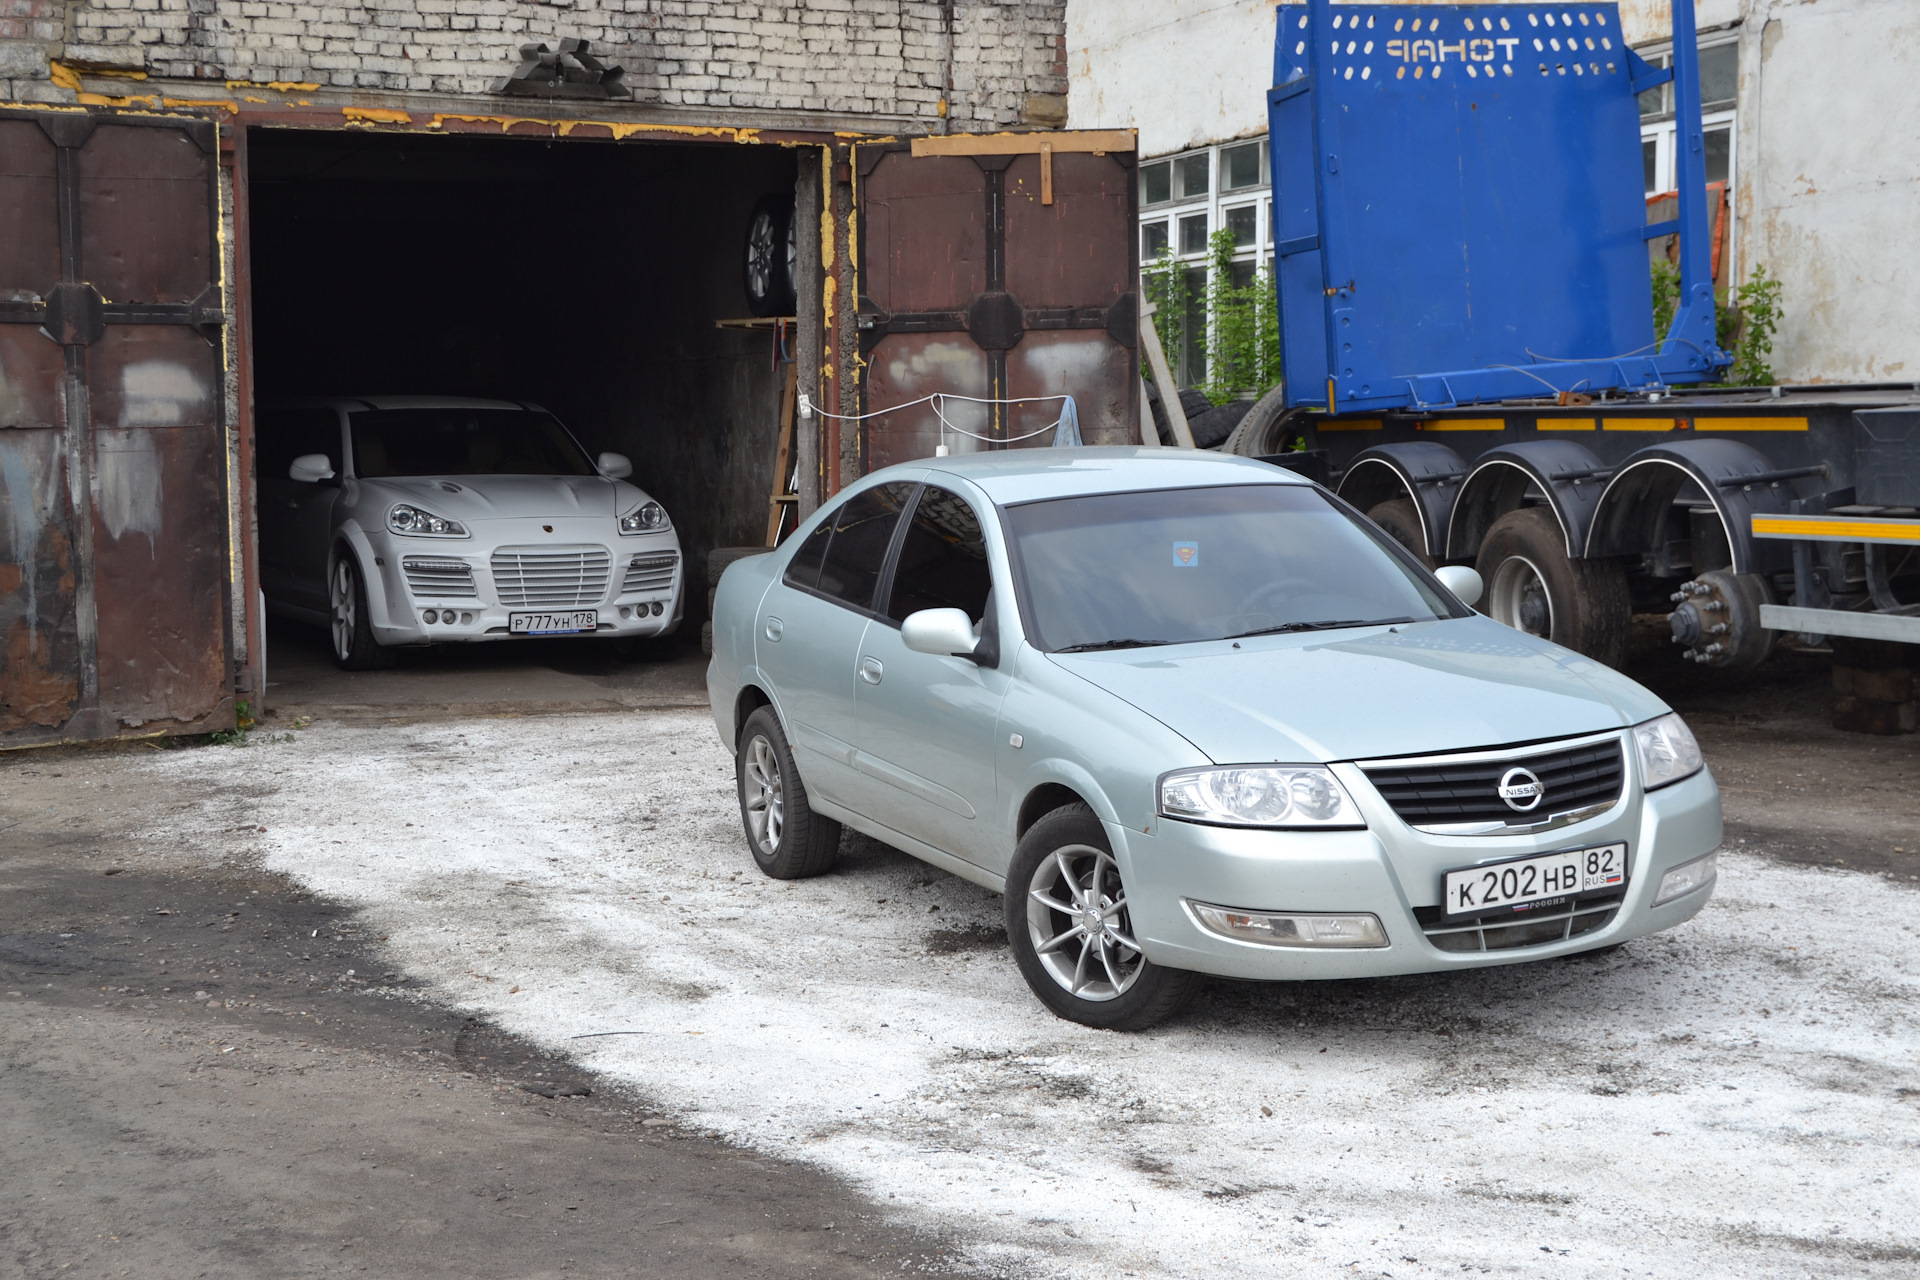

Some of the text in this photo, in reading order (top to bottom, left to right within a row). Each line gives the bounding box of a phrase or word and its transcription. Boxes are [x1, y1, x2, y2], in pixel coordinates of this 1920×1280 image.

[514, 612, 594, 630] Р777УН 178
[1505, 785, 1541, 796] NISSAN
[1459, 849, 1614, 908] К202НВ 82
[1584, 875, 1606, 887] RUS
[1529, 896, 1566, 910] РОССИЯ
